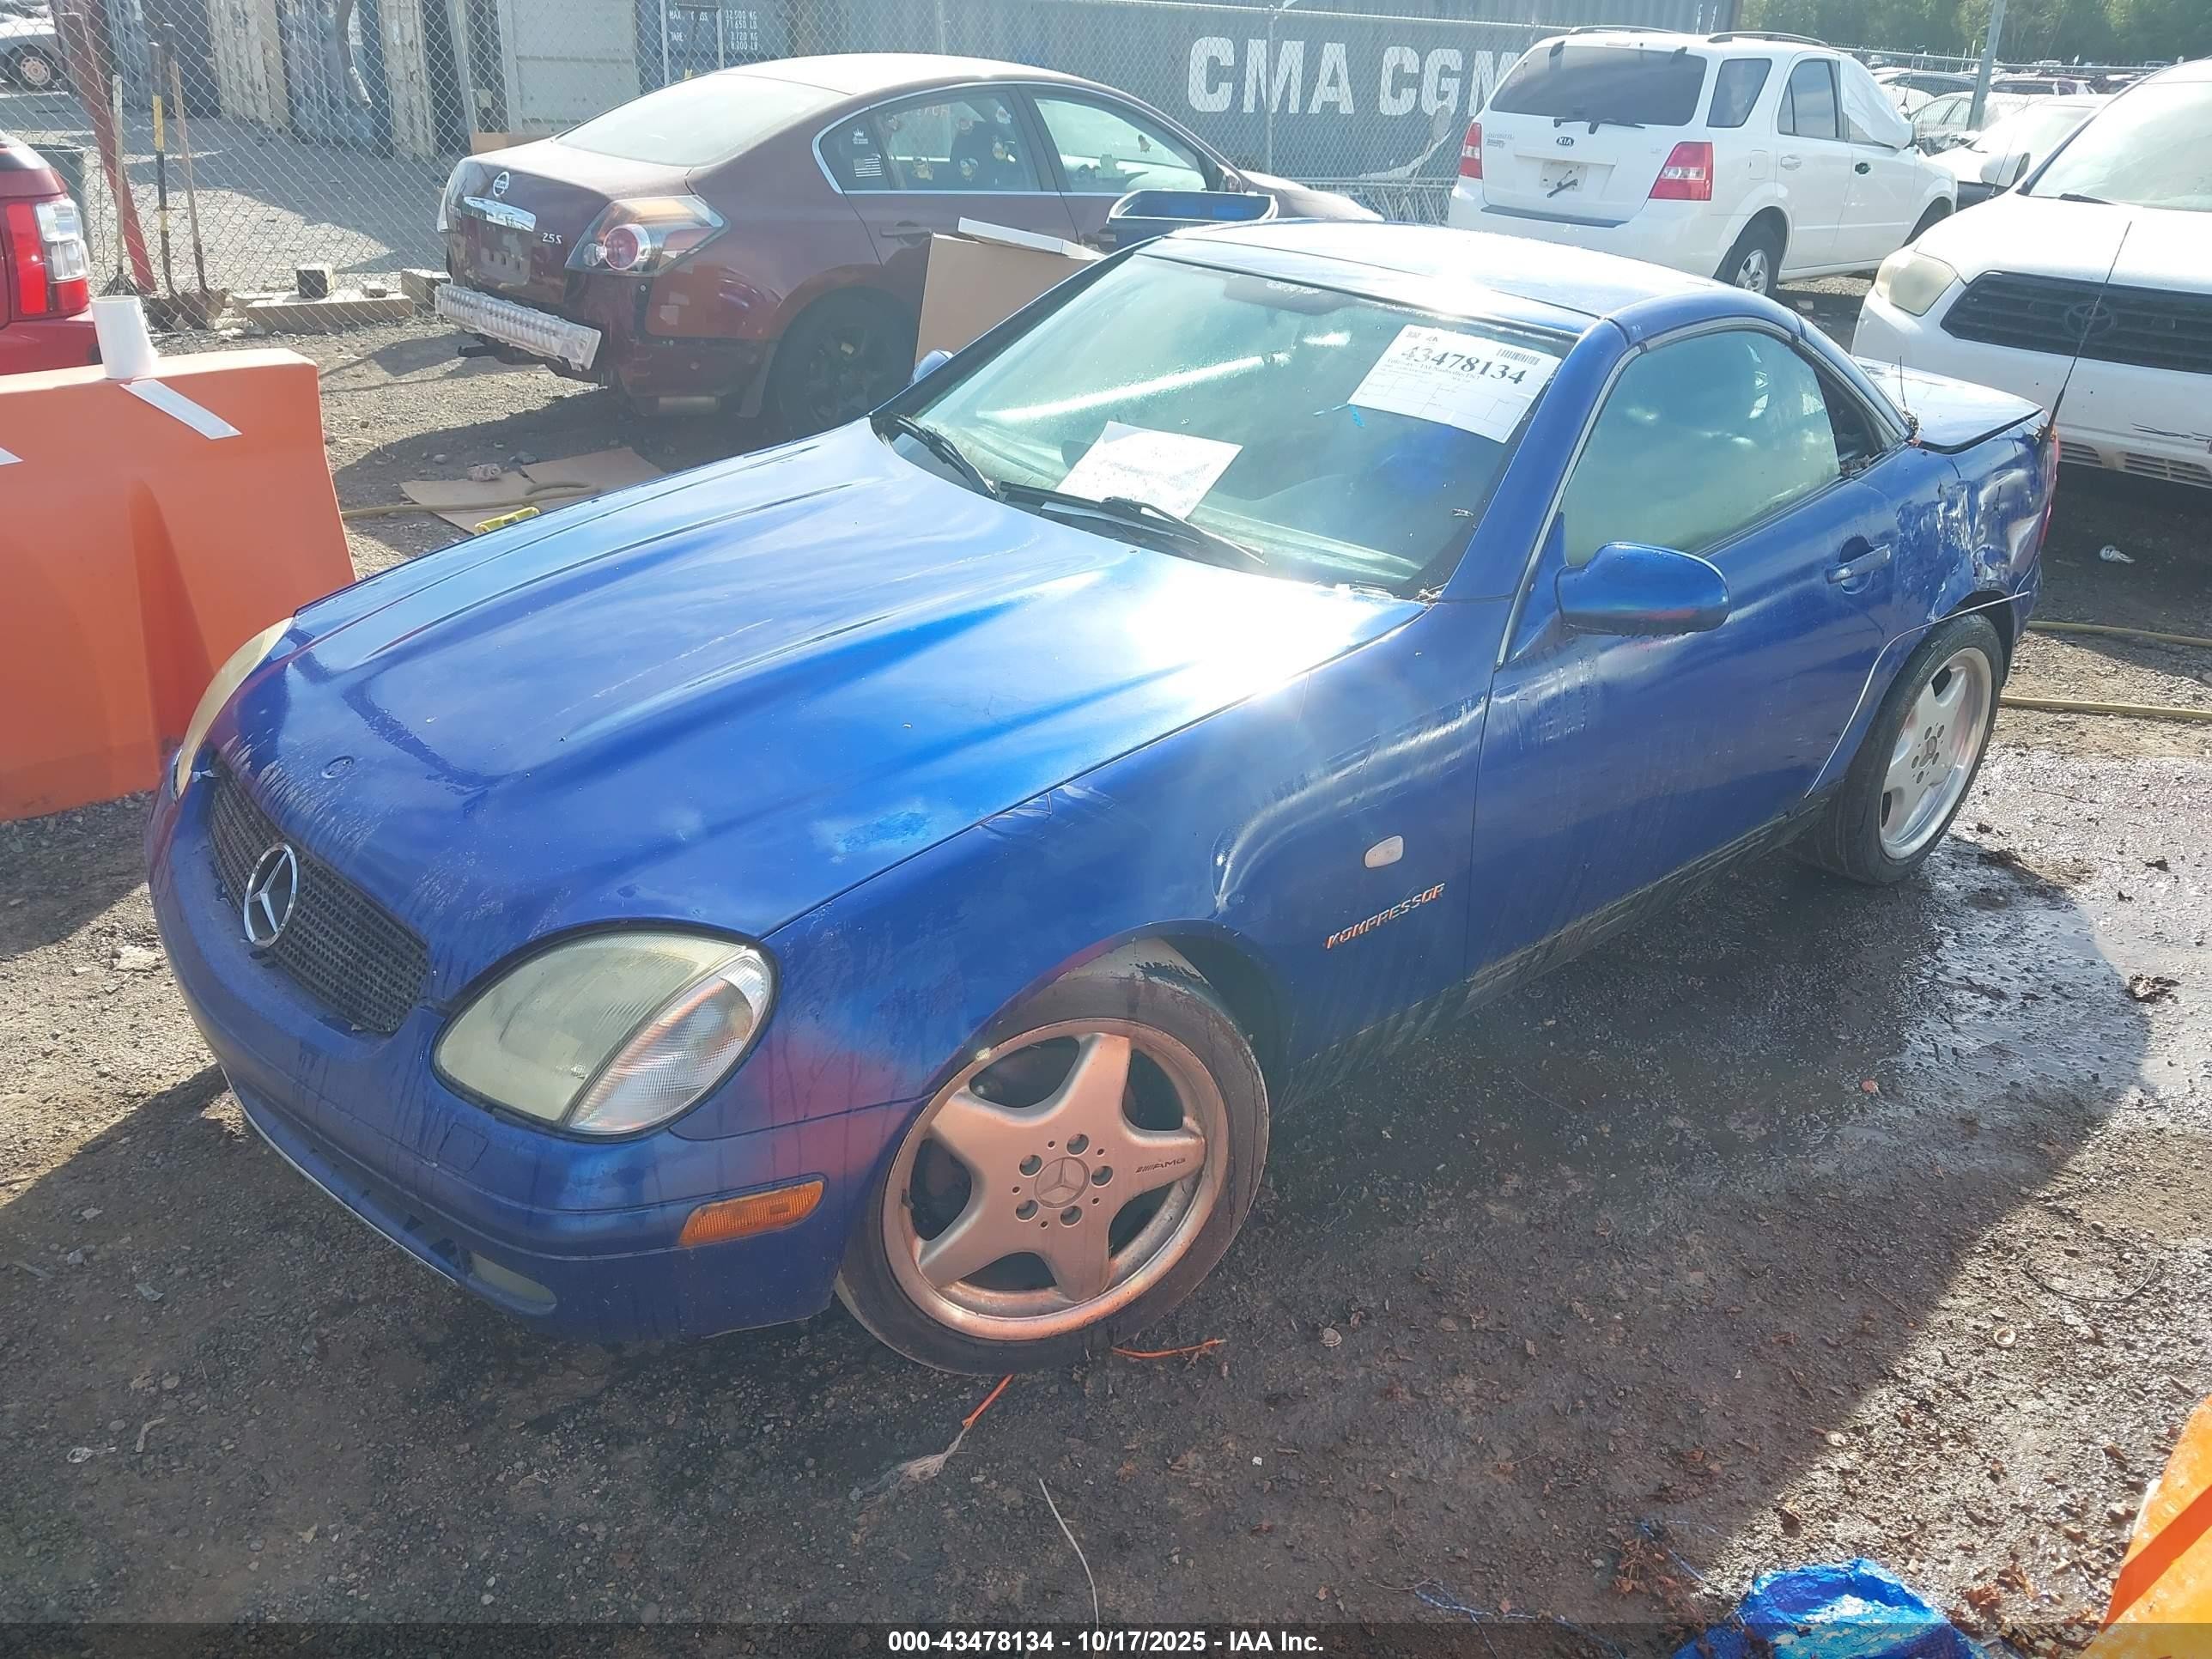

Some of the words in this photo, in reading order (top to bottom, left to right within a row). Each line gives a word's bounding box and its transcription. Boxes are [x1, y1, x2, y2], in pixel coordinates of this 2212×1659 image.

[749, 11, 757, 20] KG
[750, 33, 758, 41] KG
[750, 41, 758, 51] LB
[1188, 36, 1355, 115] CMA
[1378, 46, 1520, 118] CGM
[1558, 137, 1573, 146] KIA
[1401, 345, 1528, 385] 43478134
[1325, 883, 1445, 949] KOMPRESSOR
